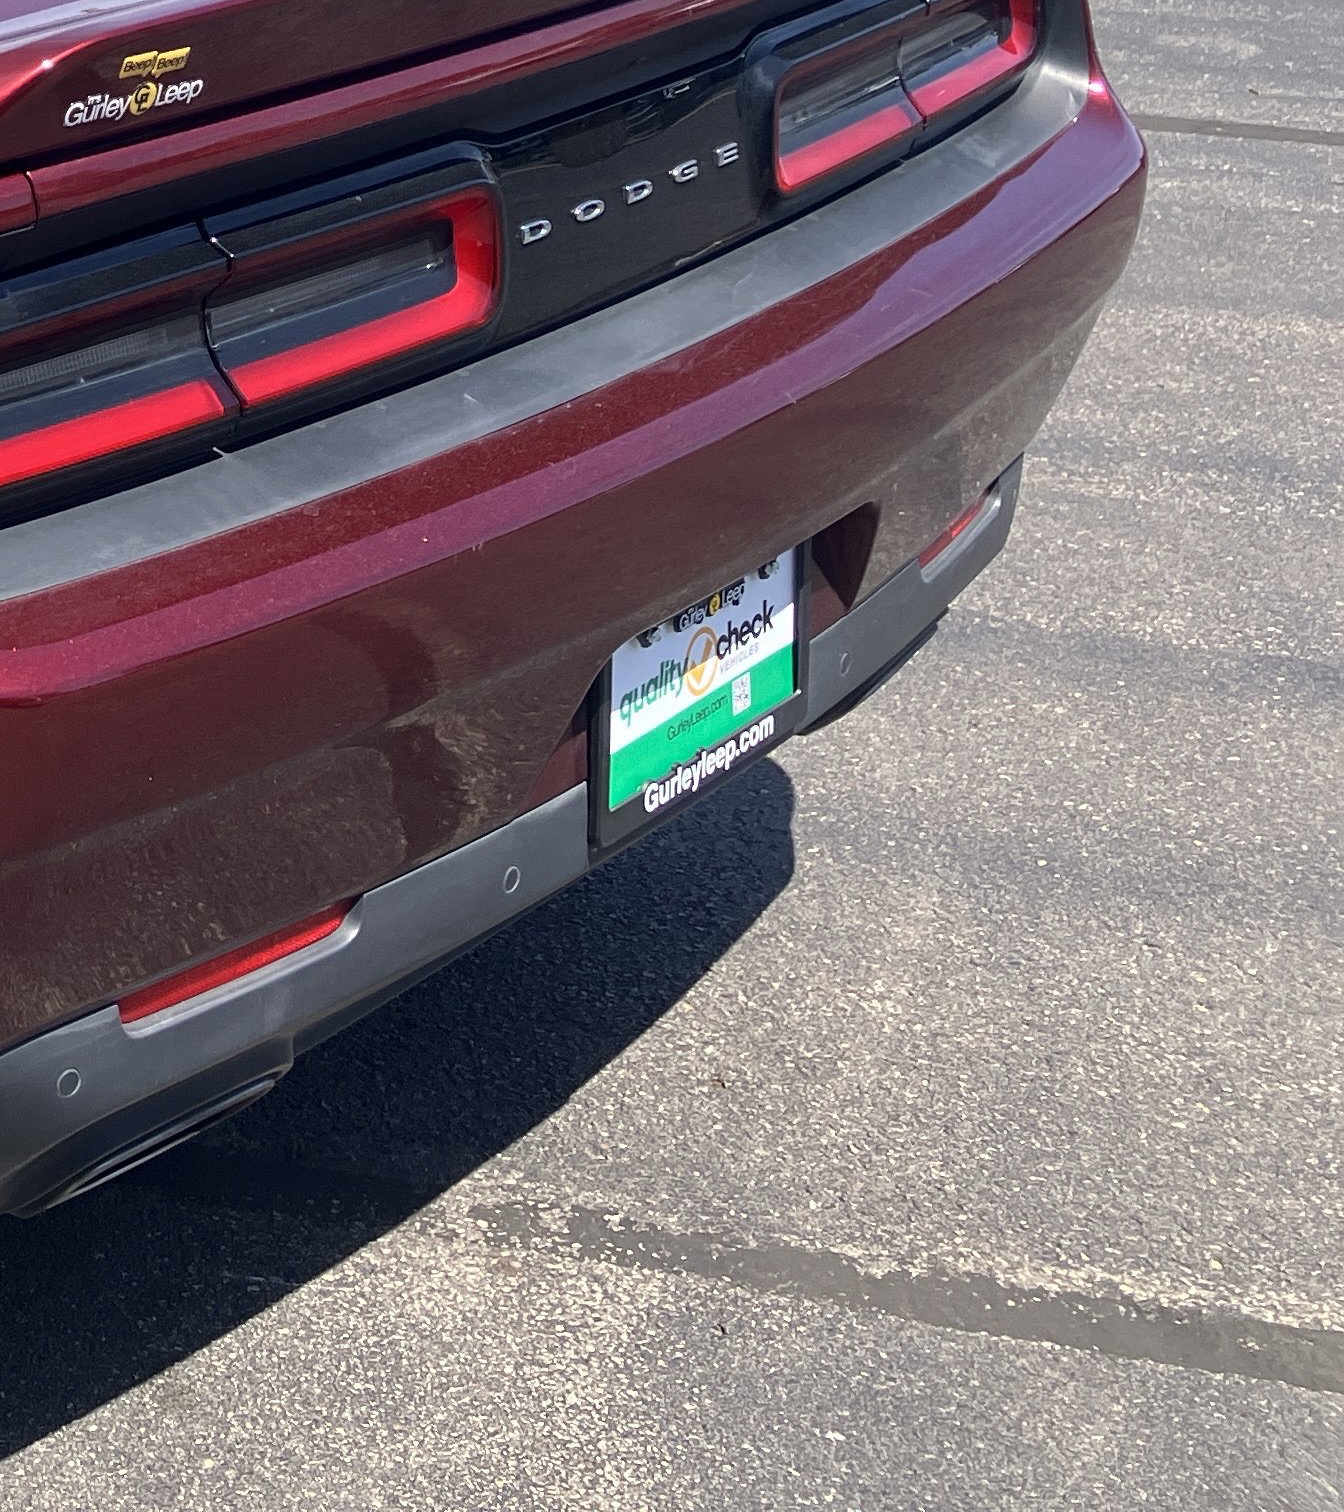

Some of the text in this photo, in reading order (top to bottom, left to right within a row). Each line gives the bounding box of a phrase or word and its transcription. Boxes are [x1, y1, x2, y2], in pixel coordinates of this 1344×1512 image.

[63, 92, 132, 127] Gurley
[154, 79, 204, 106] Leep
[518, 142, 740, 245] DODGE
[619, 599, 775, 728] quality check
[720, 642, 761, 675] VEHICLES
[643, 713, 776, 814] Gurleyleep.com
